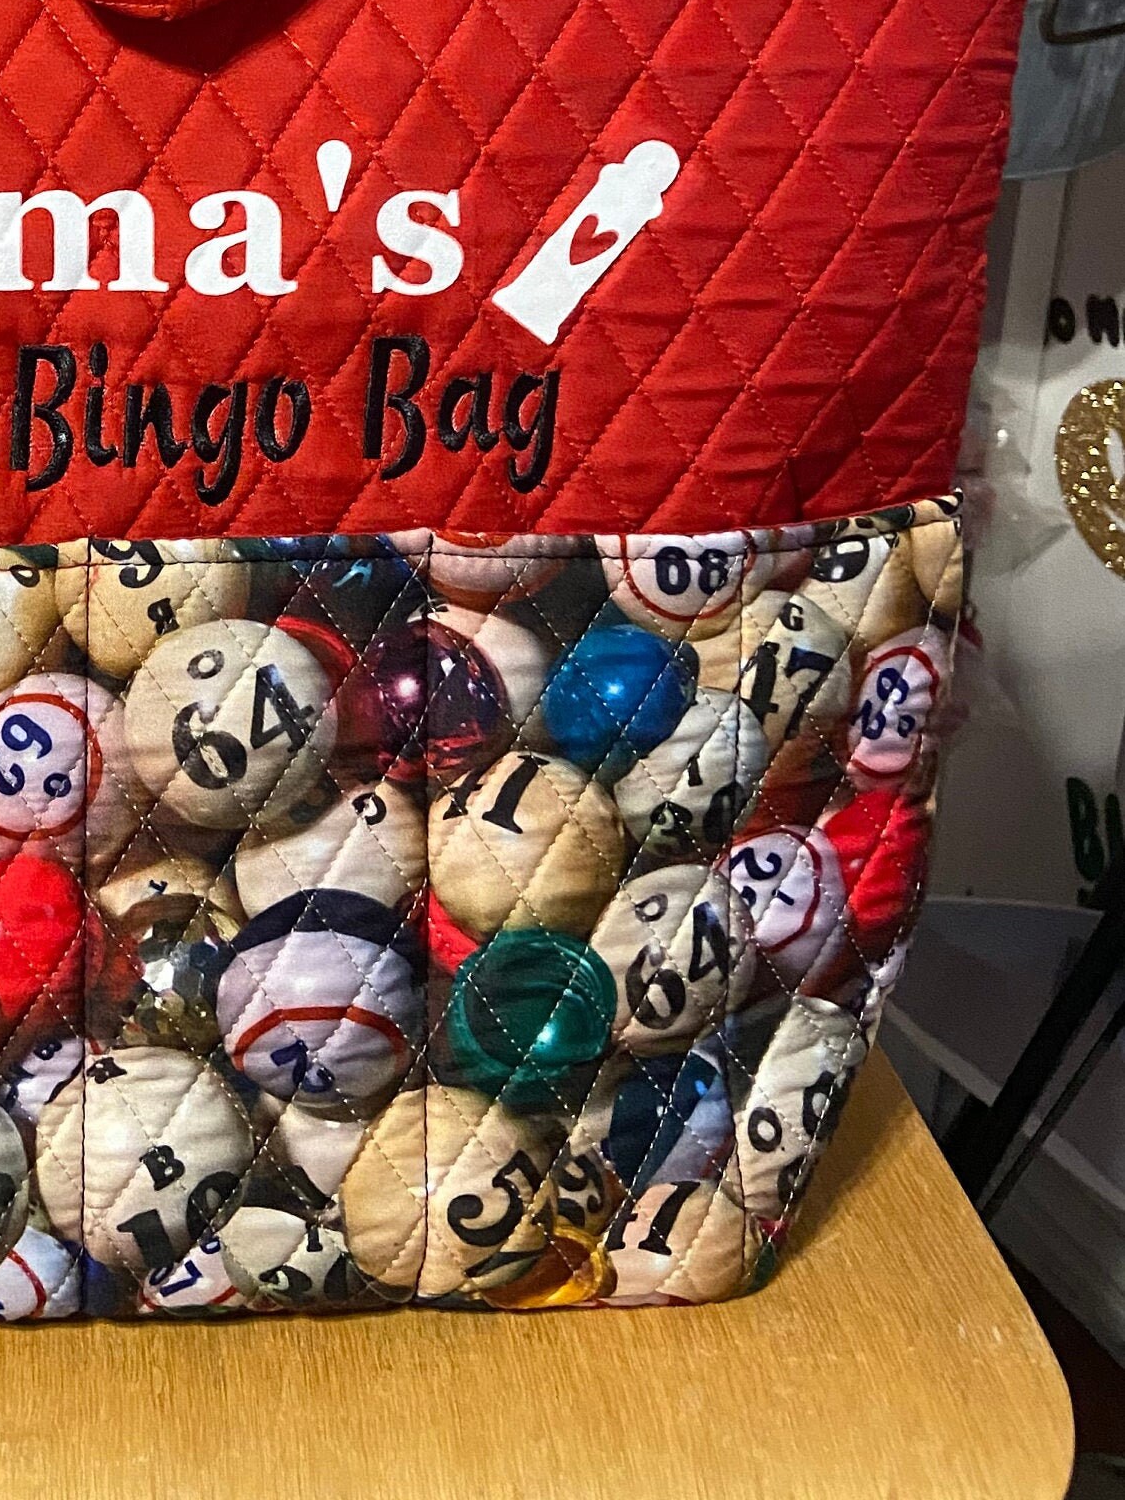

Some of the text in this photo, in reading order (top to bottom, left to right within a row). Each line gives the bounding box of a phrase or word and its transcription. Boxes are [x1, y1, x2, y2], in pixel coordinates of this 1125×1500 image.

[9, 340, 315, 507] Bingo
[363, 333, 563, 495] Bag
[171, 662, 315, 790] 64
